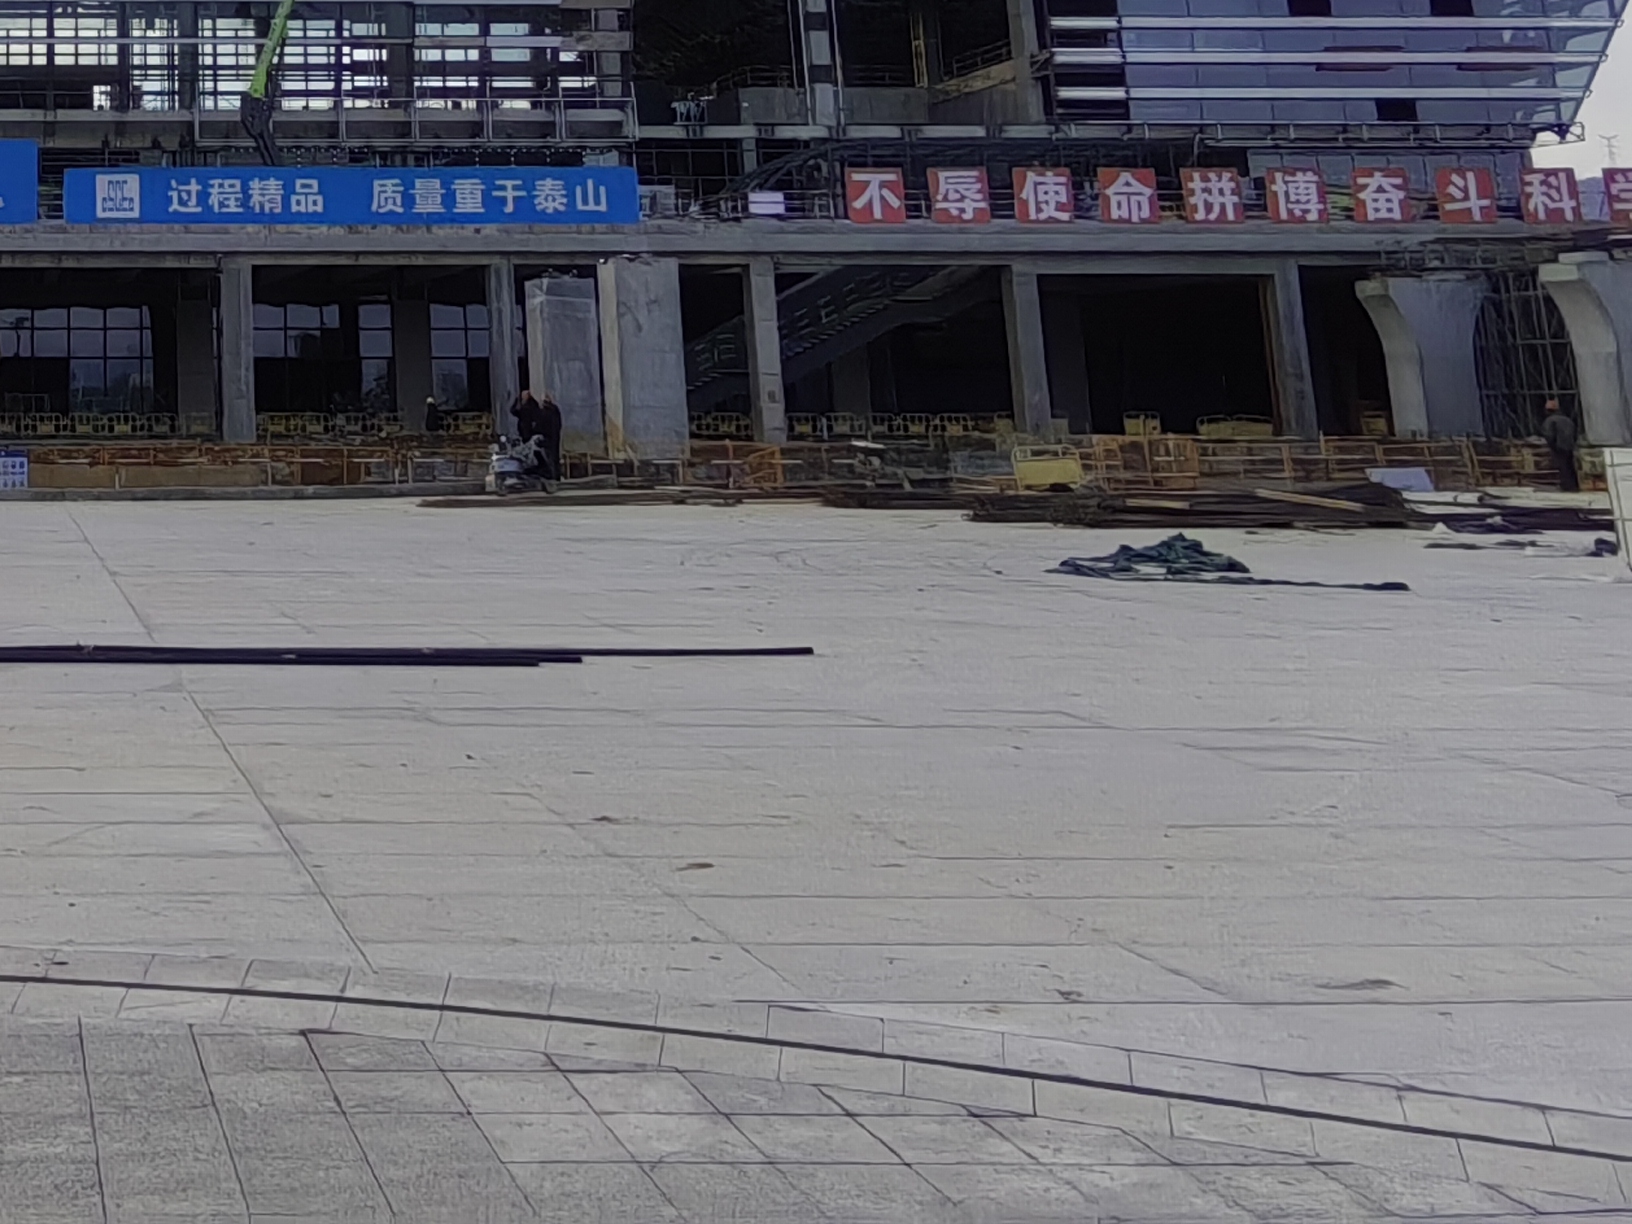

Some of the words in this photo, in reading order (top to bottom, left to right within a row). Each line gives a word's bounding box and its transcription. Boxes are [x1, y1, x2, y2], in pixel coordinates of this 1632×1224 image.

[167, 177, 324, 213] 过程精品
[371, 178, 607, 213] 质量重于泰山
